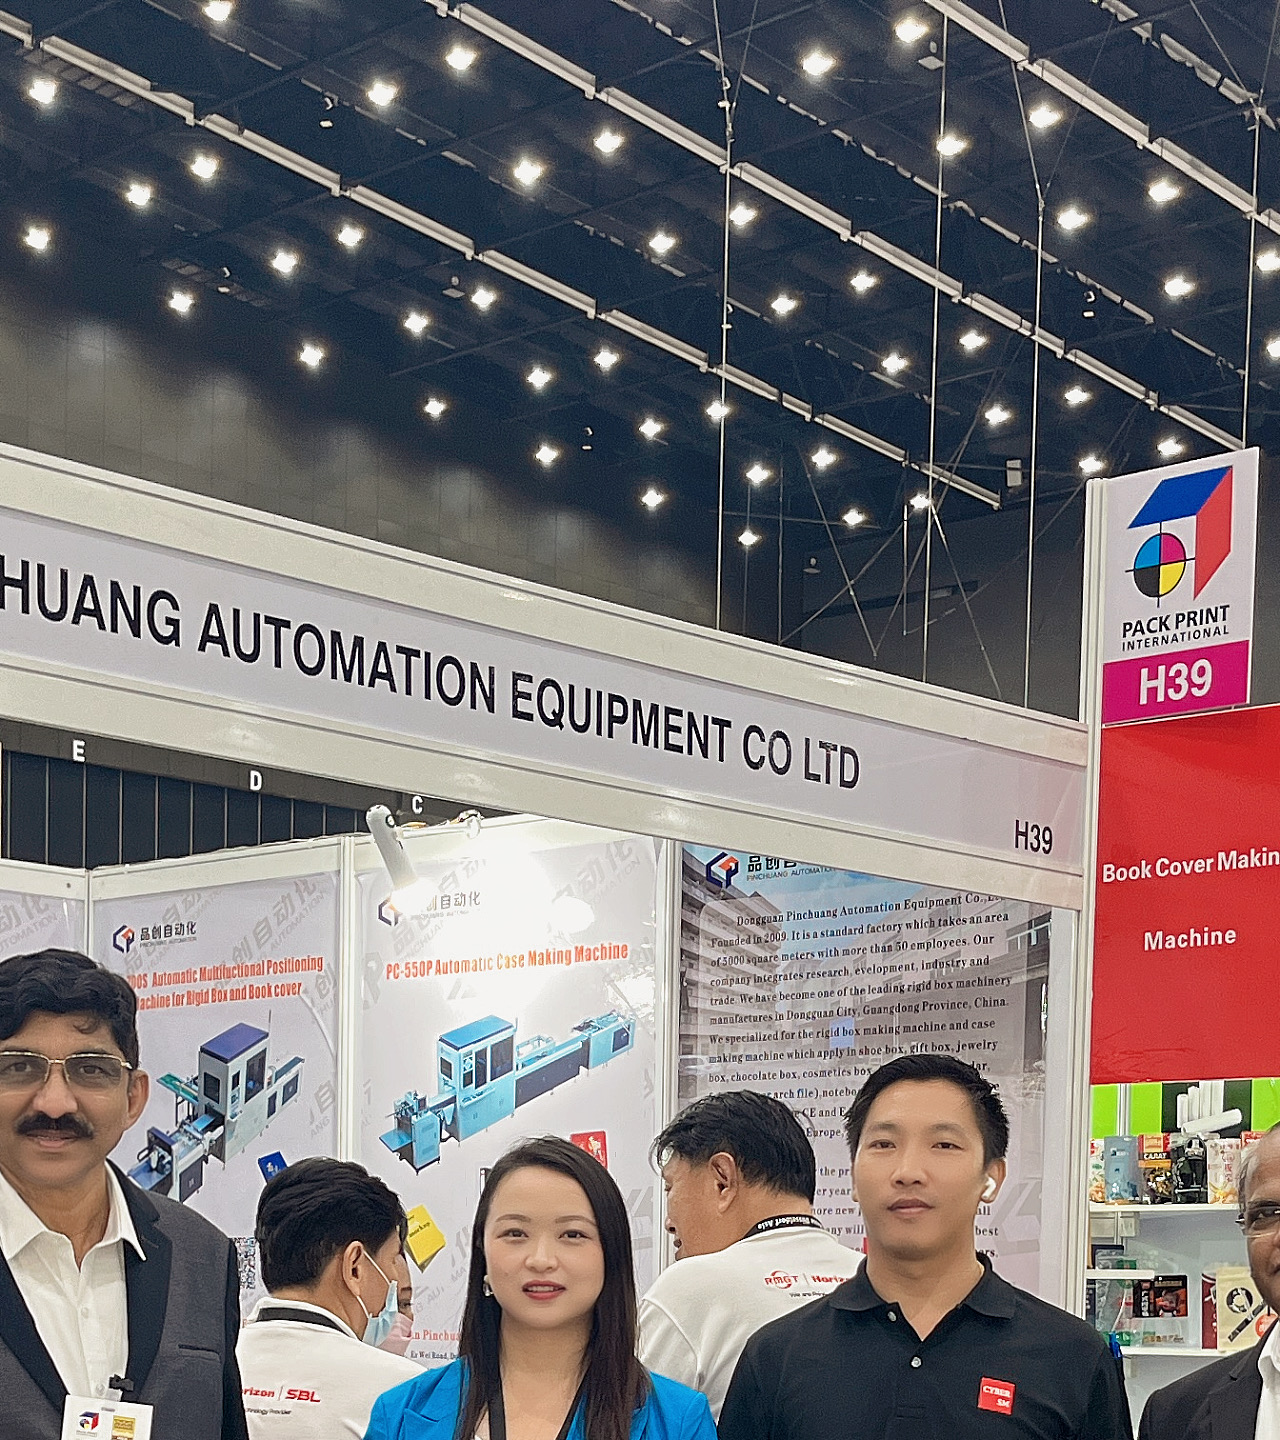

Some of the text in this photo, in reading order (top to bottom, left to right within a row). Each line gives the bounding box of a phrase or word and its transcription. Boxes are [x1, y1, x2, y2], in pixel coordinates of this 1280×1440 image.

[1122, 604, 1230, 639] PACK PRINT
[1122, 624, 1229, 652] INTERNATIONAL
[1139, 658, 1213, 706] H39
[199, 605, 495, 714] AUTOMATION
[512, 671, 732, 765] EQUIPMENT
[743, 724, 792, 776] CO
[803, 736, 860, 790] LTD
[1014, 818, 1054, 855] H39
[73, 740, 86, 763] E
[250, 771, 262, 793] D
[412, 795, 423, 814] C
[1102, 860, 1152, 883] Book
[1155, 856, 1214, 878] Cover
[736, 895, 962, 927] Dongguan Pinchuang Automation Equipment
[140, 921, 197, 941] 品创自动化
[711, 934, 751, 949] Founded
[820, 924, 864, 938] standard
[866, 922, 903, 934] factory
[905, 919, 935, 931] which
[938, 915, 967, 928] takes
[984, 912, 1009, 923] area
[1144, 926, 1237, 951] Machine
[386, 943, 629, 981] PC-550P Automatic Case Making Machine
[746, 954, 778, 967] square
[781, 949, 815, 962] meters
[817, 947, 840, 959] with
[841, 946, 868, 956] more
[870, 942, 893, 954] than
[910, 936, 970, 950] employees.
[973, 933, 995, 945] Our
[152, 955, 324, 987] Automatic Multifuctional Positioning
[710, 975, 751, 988] company
[753, 970, 804, 984] integrates
[921, 956, 967, 971] industry
[969, 954, 990, 966] and
[171, 990, 185, 1008] for
[186, 988, 210, 1008] Rigid
[211, 986, 228, 1003] Box
[229, 985, 247, 1001] and
[248, 983, 272, 1000] Book
[274, 981, 302, 997] cover
[755, 992, 777, 1003] have
[779, 988, 816, 1001] become
[817, 988, 835, 999] one
[868, 982, 905, 995] leading
[907, 980, 932, 993] rigid
[934, 979, 954, 991] box
[955, 975, 1012, 989] machinery
[709, 1013, 773, 1026] manufactures
[786, 1008, 834, 1022] Dongguan
[836, 1005, 861, 1017] City,
[863, 1003, 920, 1016] Guangdong
[285, 1388, 321, 1403] SBL
